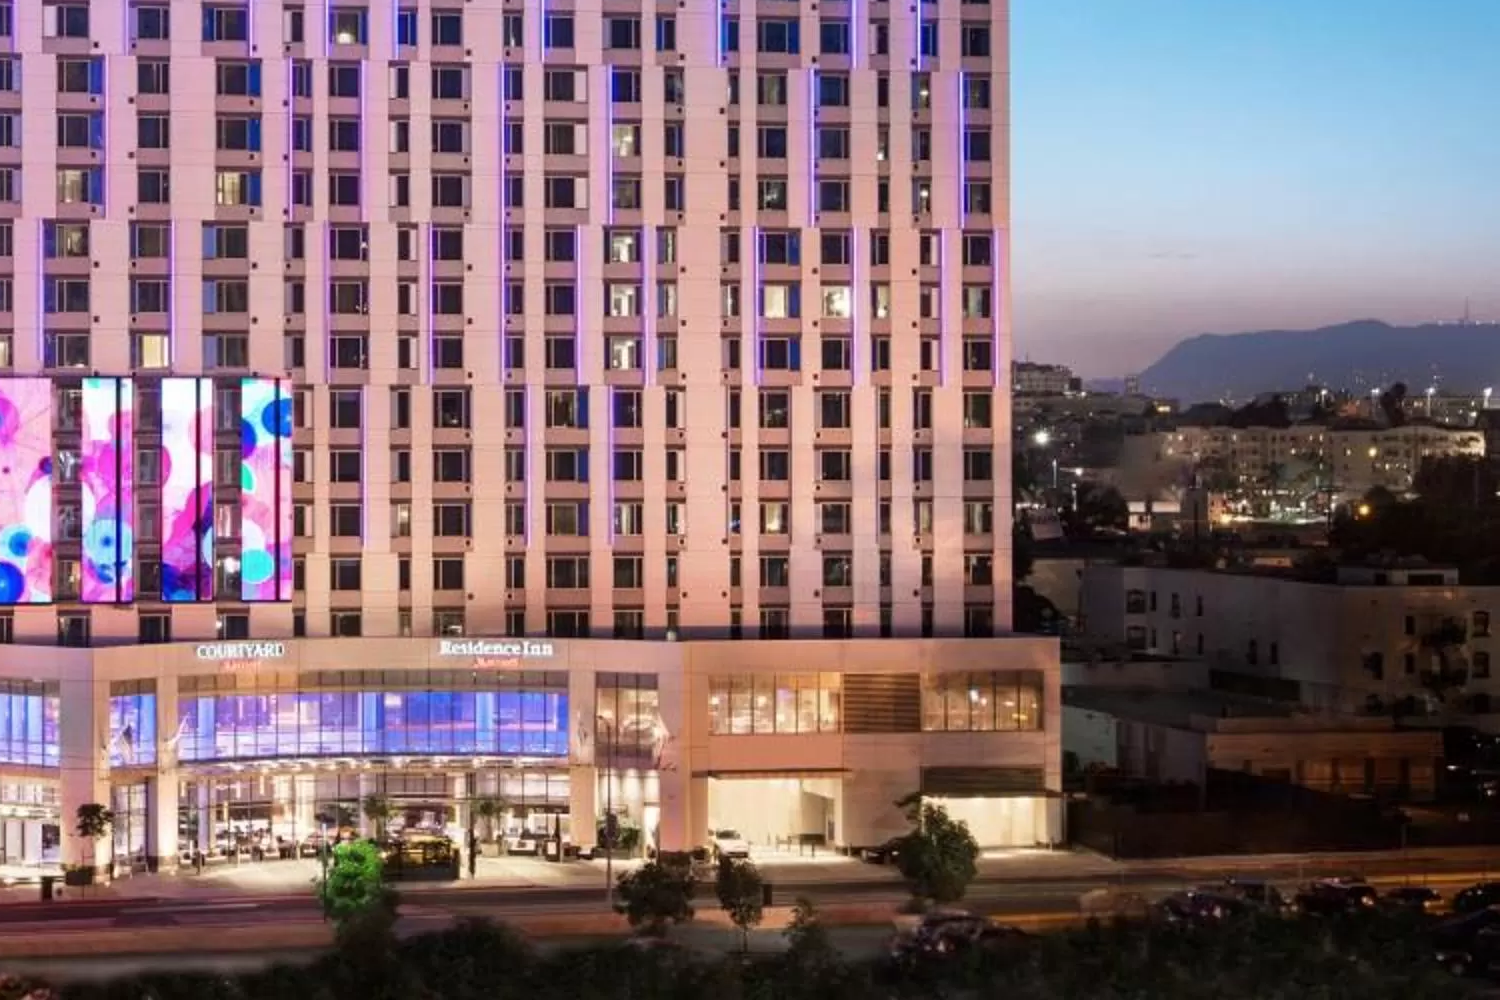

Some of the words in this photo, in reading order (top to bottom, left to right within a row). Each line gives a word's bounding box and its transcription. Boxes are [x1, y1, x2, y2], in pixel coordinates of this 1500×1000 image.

[197, 643, 285, 659] COURTYARD
[440, 640, 520, 655] Residence
[523, 641, 553, 655] Inn
